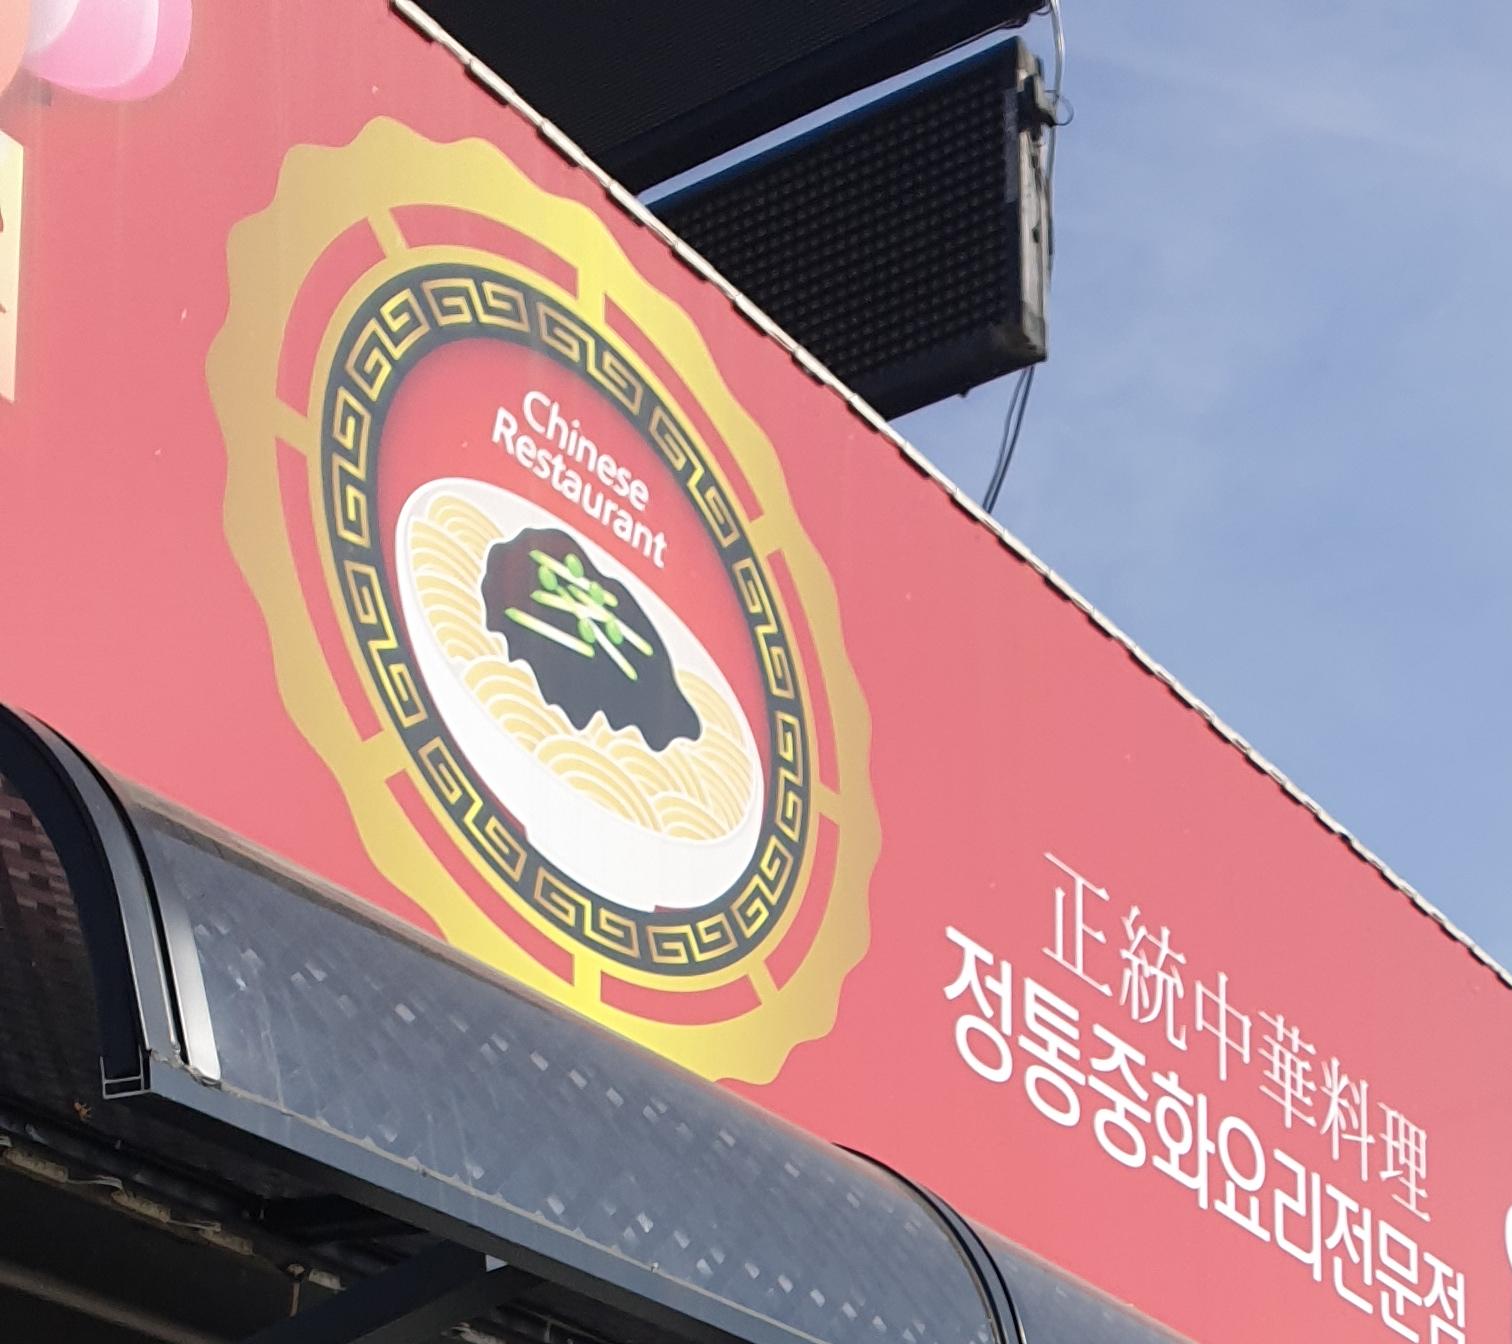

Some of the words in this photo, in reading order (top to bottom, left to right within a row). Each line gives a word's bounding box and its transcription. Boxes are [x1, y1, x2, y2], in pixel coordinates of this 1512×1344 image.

[491, 407, 668, 568] Restaurant
[522, 391, 650, 511] Chinese
[1042, 851, 1432, 1222] 正統中華料理
